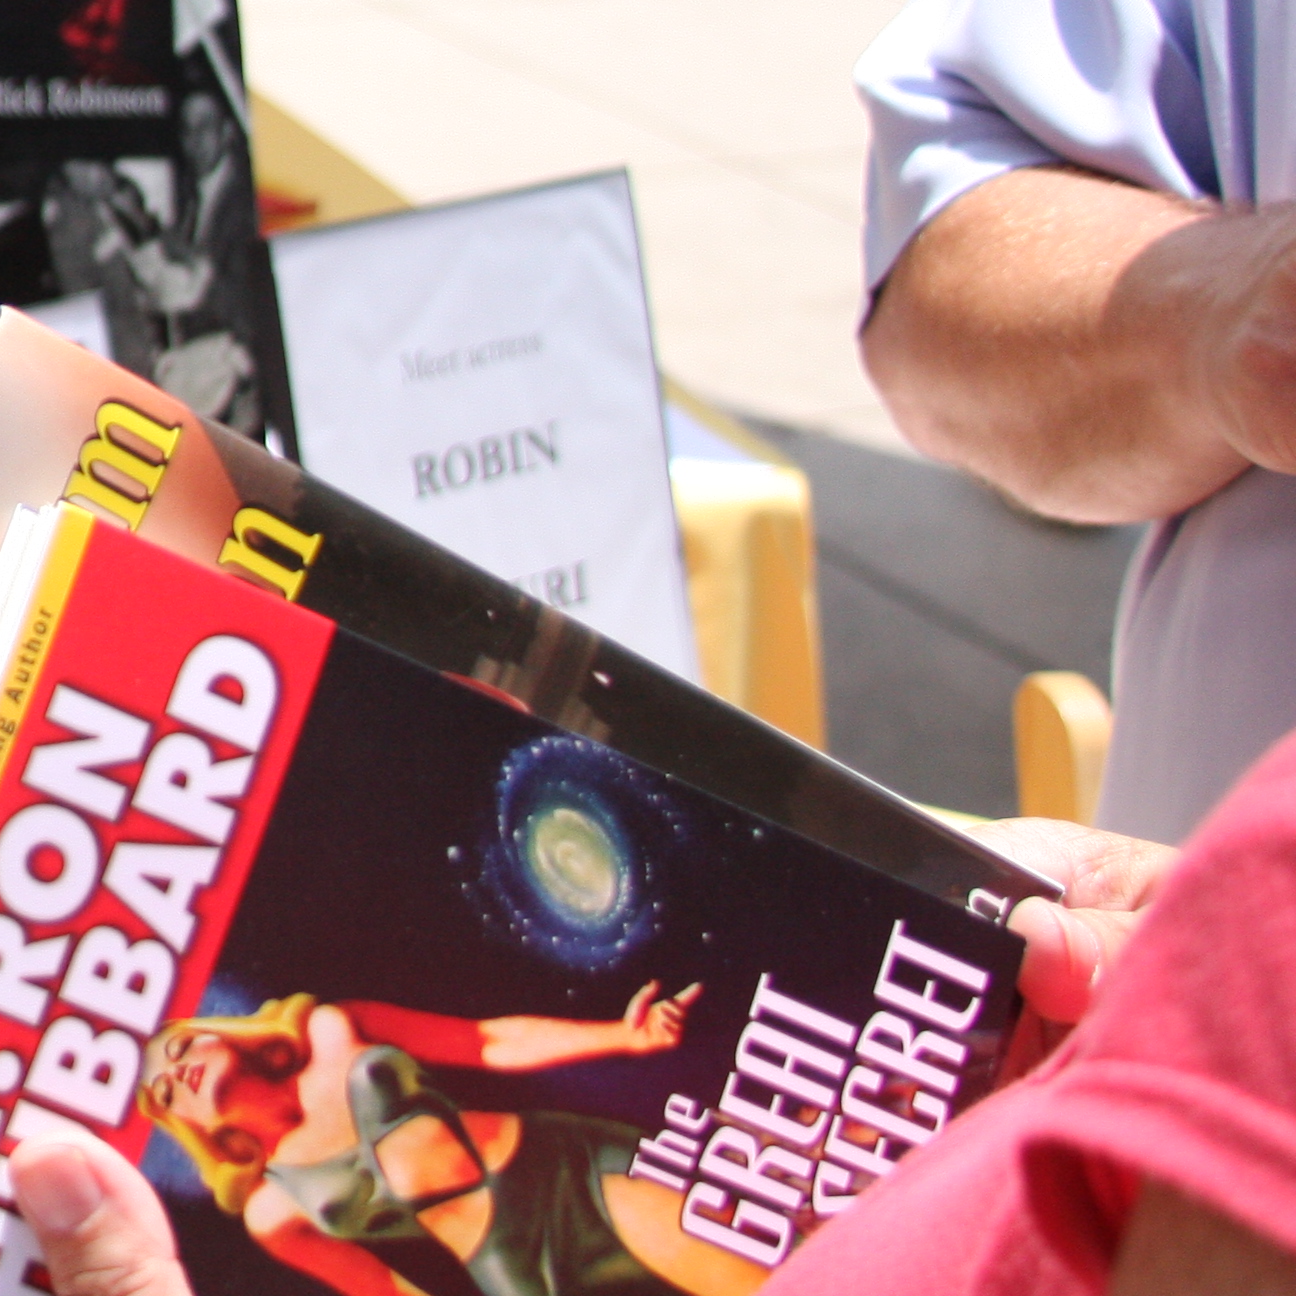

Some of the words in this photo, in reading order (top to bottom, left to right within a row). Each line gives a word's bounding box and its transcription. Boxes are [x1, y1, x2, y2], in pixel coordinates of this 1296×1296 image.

[47, 75, 168, 120] Robinson
[412, 419, 561, 500] ROBIN
[4, 604, 55, 705] Author
[628, 1092, 711, 1192] The
[680, 971, 859, 1267] GREAT
